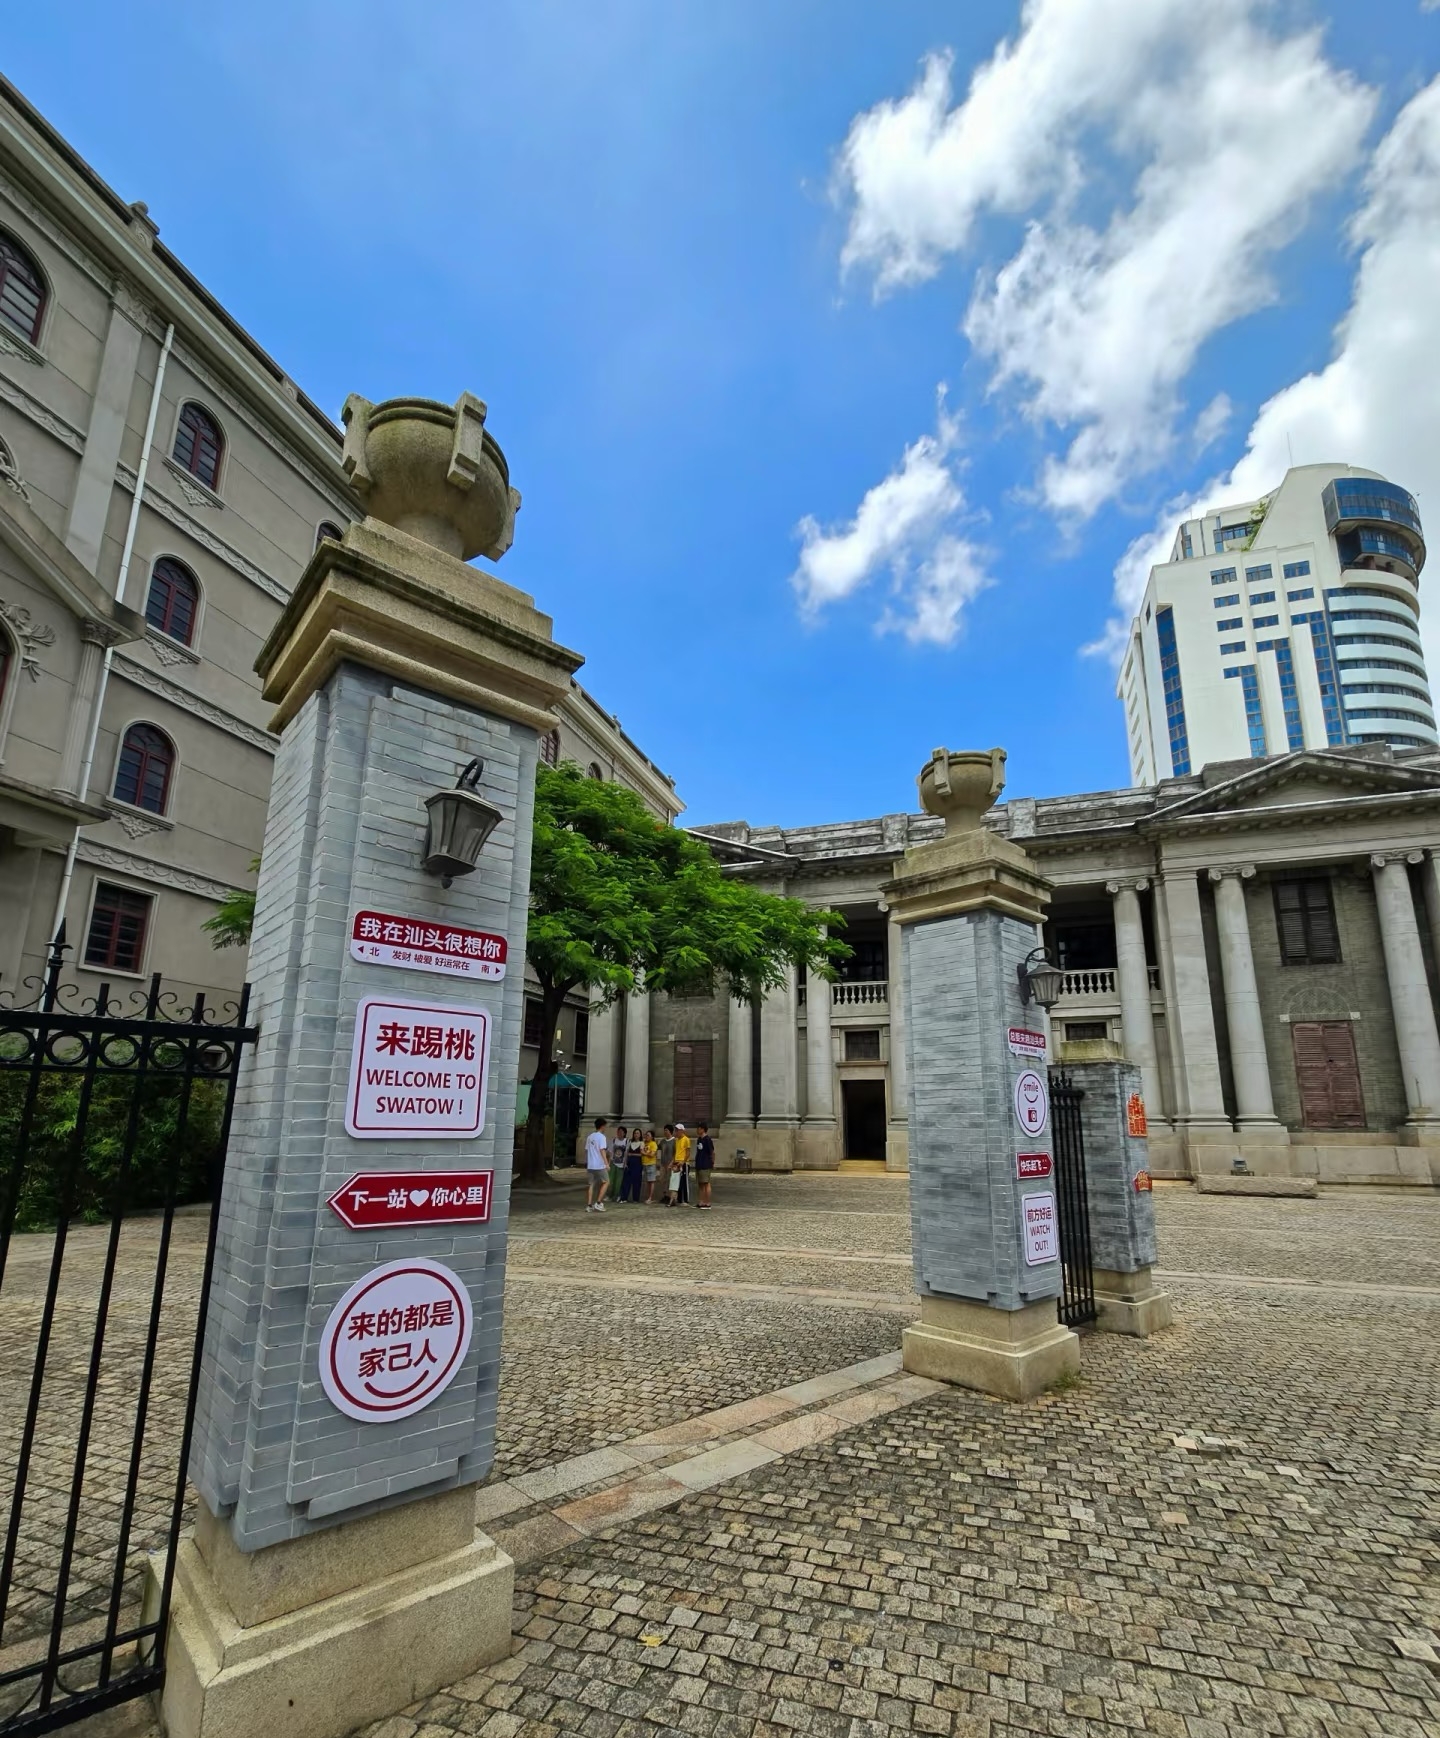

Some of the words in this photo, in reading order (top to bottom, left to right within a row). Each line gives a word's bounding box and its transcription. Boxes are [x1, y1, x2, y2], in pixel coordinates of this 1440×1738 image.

[360, 917, 501, 959] 我在汕头很想你
[369, 947, 380, 957] 北
[392, 950, 412, 962] 发财
[414, 954, 433, 966] 被爱
[435, 957, 470, 971] 好运常在
[481, 964, 490, 974] 南
[375, 1022, 476, 1061] 来踢桃
[366, 1069, 451, 1089] WELCOME
[456, 1074, 476, 1090] TO
[1024, 1083, 1038, 1092] smile
[376, 1096, 454, 1115] SWATOW
[1027, 1207, 1052, 1222] 前方好运
[1030, 1224, 1051, 1237] WATCH
[1034, 1240, 1049, 1252] OUT!
[347, 1300, 454, 1341] 来的都是
[358, 1339, 438, 1379] 家己人
